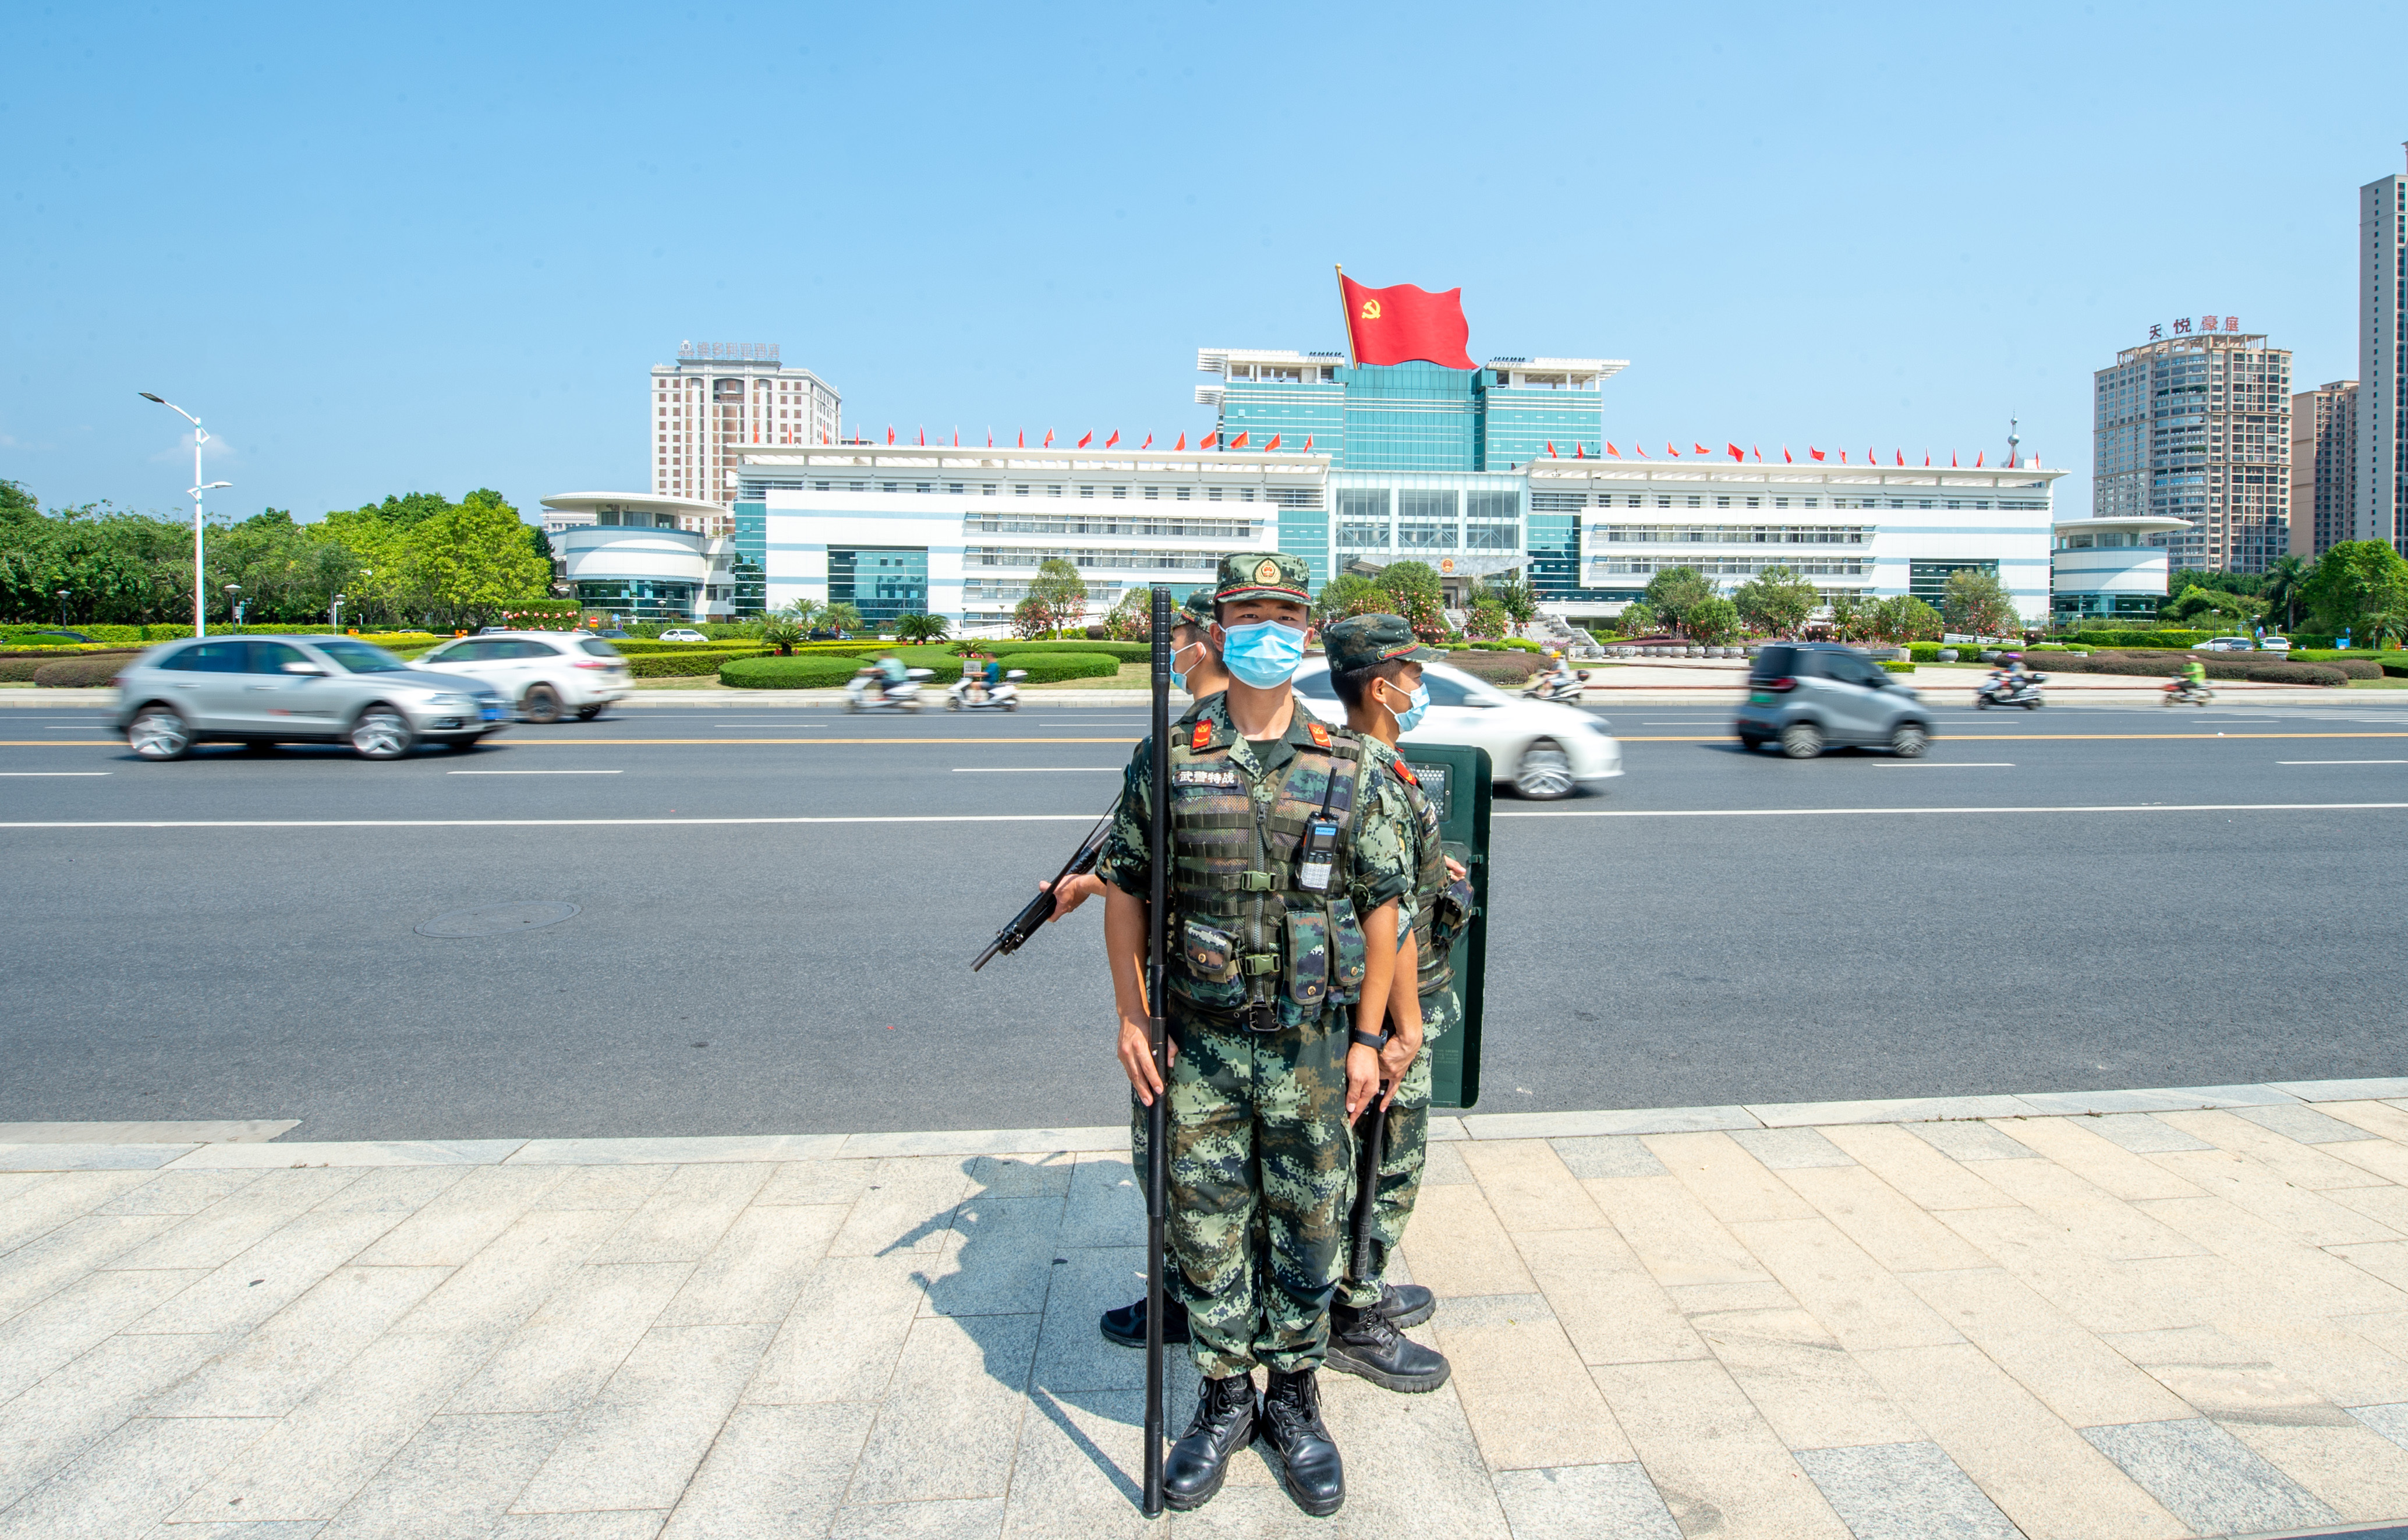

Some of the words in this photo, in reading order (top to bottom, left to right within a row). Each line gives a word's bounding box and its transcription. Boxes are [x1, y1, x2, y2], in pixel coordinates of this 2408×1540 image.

[2149, 315, 2239, 340] 天悦豪庭
[697, 341, 780, 358] 维多利亚酒店
[1180, 770, 1235, 784] 武警特战
